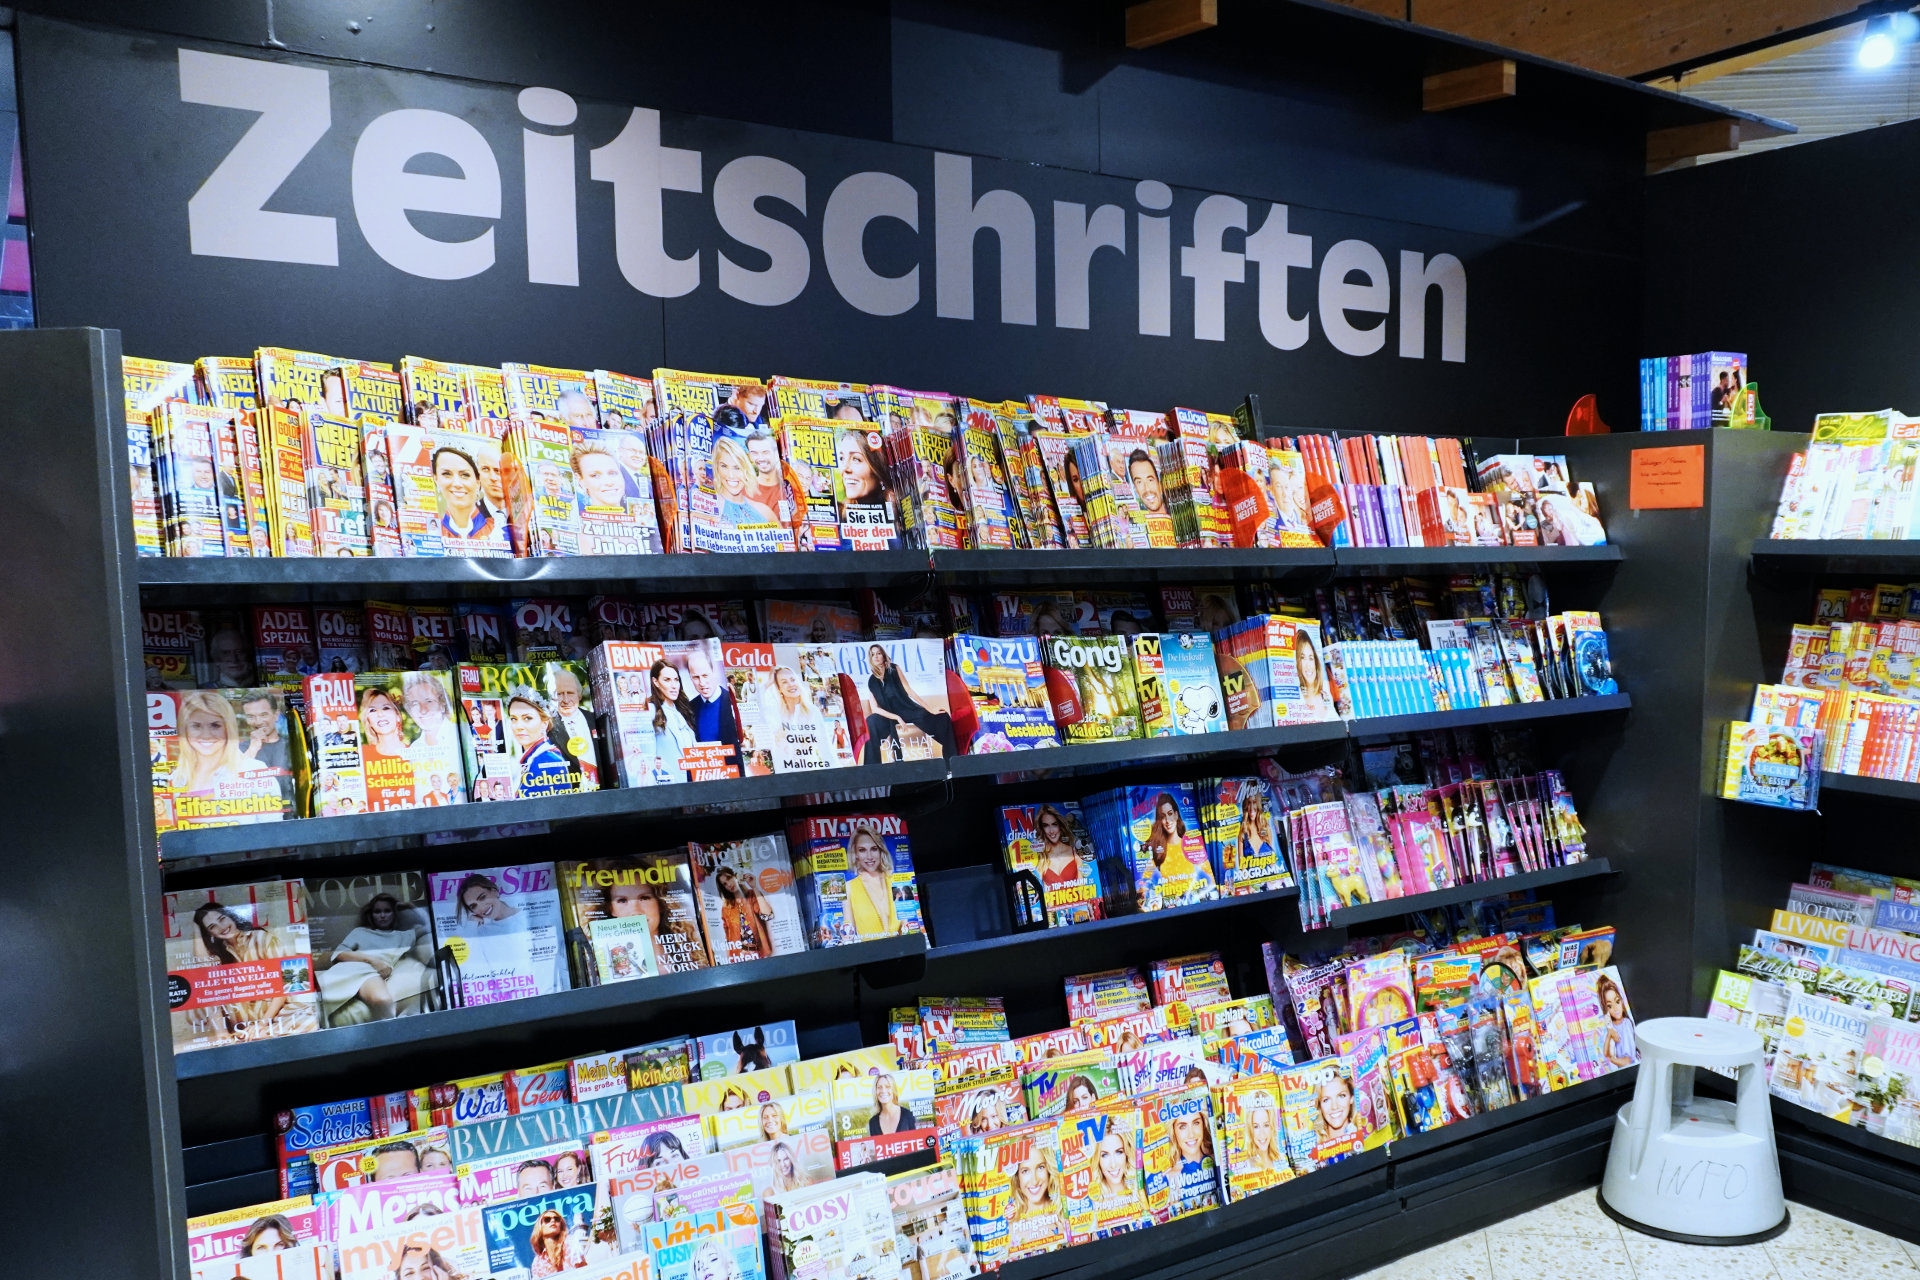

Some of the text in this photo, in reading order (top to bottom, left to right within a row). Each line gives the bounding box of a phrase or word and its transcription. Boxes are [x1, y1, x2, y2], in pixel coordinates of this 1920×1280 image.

[178, 49, 1467, 363] Zeitschriften
[776, 389, 825, 412] REVUE
[1178, 411, 1208, 426] GLÜCKS
[528, 421, 569, 445] Neue
[690, 422, 712, 441] NEUE
[1180, 423, 1209, 437] REVUE
[690, 435, 713, 454] BLATT
[789, 430, 835, 450] FREIZEIT
[531, 441, 571, 463] Post
[792, 446, 838, 467] REVUE
[538, 495, 572, 511] Alles
[1234, 496, 1257, 513] WOCHE
[1312, 497, 1335, 515] WOCHE
[543, 508, 571, 521] aus!
[848, 511, 885, 524] Sie ist
[1236, 506, 1259, 522] HEUTE
[1314, 508, 1337, 523] HEUTE
[583, 520, 656, 540] Zwillings-
[694, 524, 794, 543] Neuanfang in Italien!
[843, 524, 895, 539] über den
[443, 538, 467, 548] Liebe
[469, 539, 486, 549] statt
[487, 540, 509, 550] Krone
[695, 536, 777, 553] Ein Liebesnest am See
[1162, 589, 1193, 601] FUNK
[1167, 599, 1193, 611] UHR
[261, 612, 309, 632] ADEL
[467, 614, 502, 639] IN
[516, 603, 573, 634] OK!
[262, 630, 312, 645] SPEZIAL
[1267, 624, 1295, 635] auf einen
[1136, 636, 1160, 656] tv
[1269, 636, 1287, 647] Blick
[611, 645, 663, 670] BUNTE
[726, 647, 776, 668] Gala
[1053, 639, 1124, 674] Gong
[461, 668, 481, 684] FRAU
[1223, 671, 1246, 696] tv
[310, 679, 356, 707] FRAU
[1138, 677, 1158, 701] tv
[1227, 691, 1249, 703] Hören
[1230, 704, 1250, 715] Sehen
[781, 722, 817, 733] Neues
[1004, 722, 1056, 739] Geschichte
[1067, 722, 1113, 738] Waldes
[786, 733, 818, 745] Glück
[879, 735, 936, 750] DAS HAT
[707, 746, 736, 761] gehen
[796, 746, 814, 757] auf
[257, 767, 282, 778] nein!
[365, 757, 449, 777] Millionen-
[680, 758, 724, 771] durch die
[783, 757, 832, 770] Mallorca
[1756, 763, 1798, 778] LECKER
[219, 779, 274, 790] Beatrice Egli
[381, 788, 411, 799] für die
[175, 794, 291, 817] Eifersuchts-
[816, 818, 902, 837] TV TODAY
[1008, 828, 1037, 841] direkt
[1239, 854, 1279, 870] Pfingst-
[499, 866, 551, 897] SIE
[1233, 864, 1286, 882] PROGRAMM
[1043, 884, 1097, 906] PFINGSTEN
[1790, 899, 1871, 927] WOHNEN
[1775, 911, 1848, 944] LIVING
[654, 932, 687, 946] MEIN
[662, 941, 701, 955] BLICK
[711, 938, 743, 951] Kleine
[657, 952, 692, 966] NACH
[664, 961, 699, 974] VORN
[194, 971, 281, 989] ELLE TRAVELLER
[208, 964, 266, 979] IHR EXTRA:
[1164, 968, 1183, 991] TV
[1432, 964, 1471, 979] Benjamin
[472, 974, 535, 992] 10 BESTEN
[1719, 973, 1751, 993] WOHN
[1071, 983, 1095, 1006] TV
[1717, 987, 1748, 1005] IDEE
[923, 1011, 954, 1038] tv
[1198, 1007, 1245, 1033] tv schlau
[1796, 1000, 1868, 1036] wohnen
[233, 1014, 298, 1042] STIL!
[1107, 1015, 1168, 1044] DIGITAL
[1028, 1031, 1087, 1061] DIGITAL
[1240, 1032, 1281, 1051] piccolino
[577, 1061, 606, 1085] Mein
[948, 1048, 1004, 1079] DIGITAL
[1242, 1051, 1266, 1076] TV
[630, 1066, 661, 1089] Mein
[1281, 1074, 1303, 1092] tv
[323, 1101, 366, 1117] WAHRE
[574, 1083, 683, 1135] BAZAAR
[953, 1083, 1020, 1122] Movie
[1226, 1092, 1242, 1118] tv
[1140, 1097, 1206, 1129] TV clever
[454, 1106, 574, 1162] BAZAAR
[611, 1123, 651, 1142] Erdbeeren
[1062, 1114, 1109, 1155] pur TV
[876, 1138, 925, 1158] 2 HEFTE
[976, 1137, 1035, 1174] tv pur
[1317, 1142, 1353, 1160] Pfingsten
[602, 1142, 656, 1176] Frau
[610, 1162, 700, 1198] InStyle
[1177, 1168, 1215, 1188] Wochen
[1258, 1171, 1293, 1186] TV-Hits
[1656, 1158, 1749, 1202] INFO
[692, 1185, 716, 1199] GRÜNE
[718, 1179, 752, 1193] Kochbuch
[207, 1199, 309, 1227] Urteile helfen Sparen
[494, 1190, 595, 1243] petra
[789, 1193, 851, 1233] cosy
[1012, 1213, 1059, 1234] Pfingsten
[190, 1231, 246, 1265] plus
[342, 1209, 482, 1272] myself
